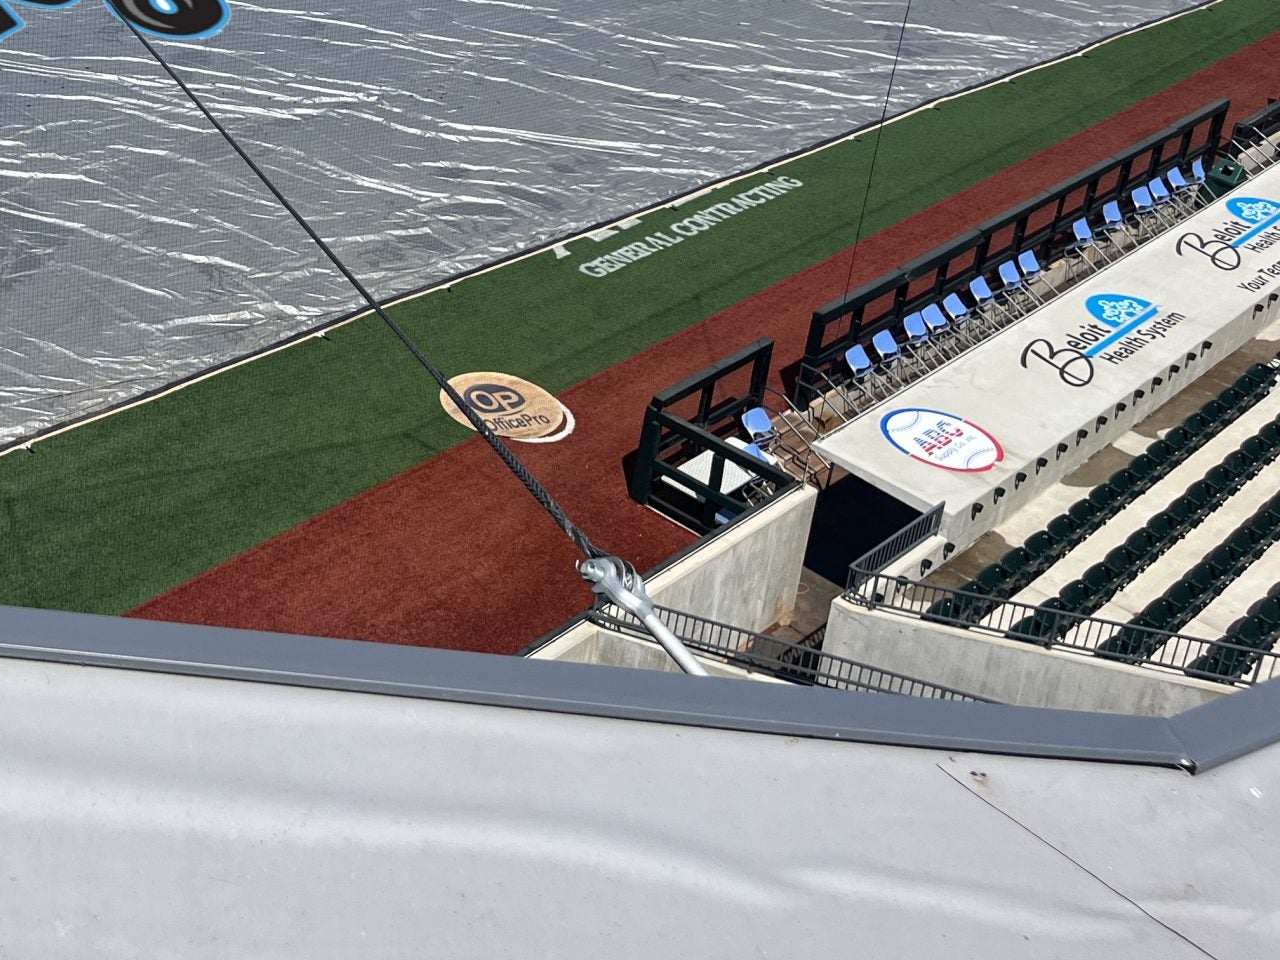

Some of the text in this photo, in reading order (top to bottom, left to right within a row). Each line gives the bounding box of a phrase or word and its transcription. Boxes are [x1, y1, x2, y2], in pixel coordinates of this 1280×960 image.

[579, 232, 684, 277] GENERAL
[672, 175, 804, 237] CONTRACTING
[1176, 220, 1251, 270] Beloit
[1236, 275, 1269, 292] Your
[1020, 323, 1112, 387] Beloit
[1099, 312, 1186, 365] Health System
[469, 390, 519, 410] OP
[483, 413, 550, 432] OfficePro
[913, 420, 964, 457] ABC
